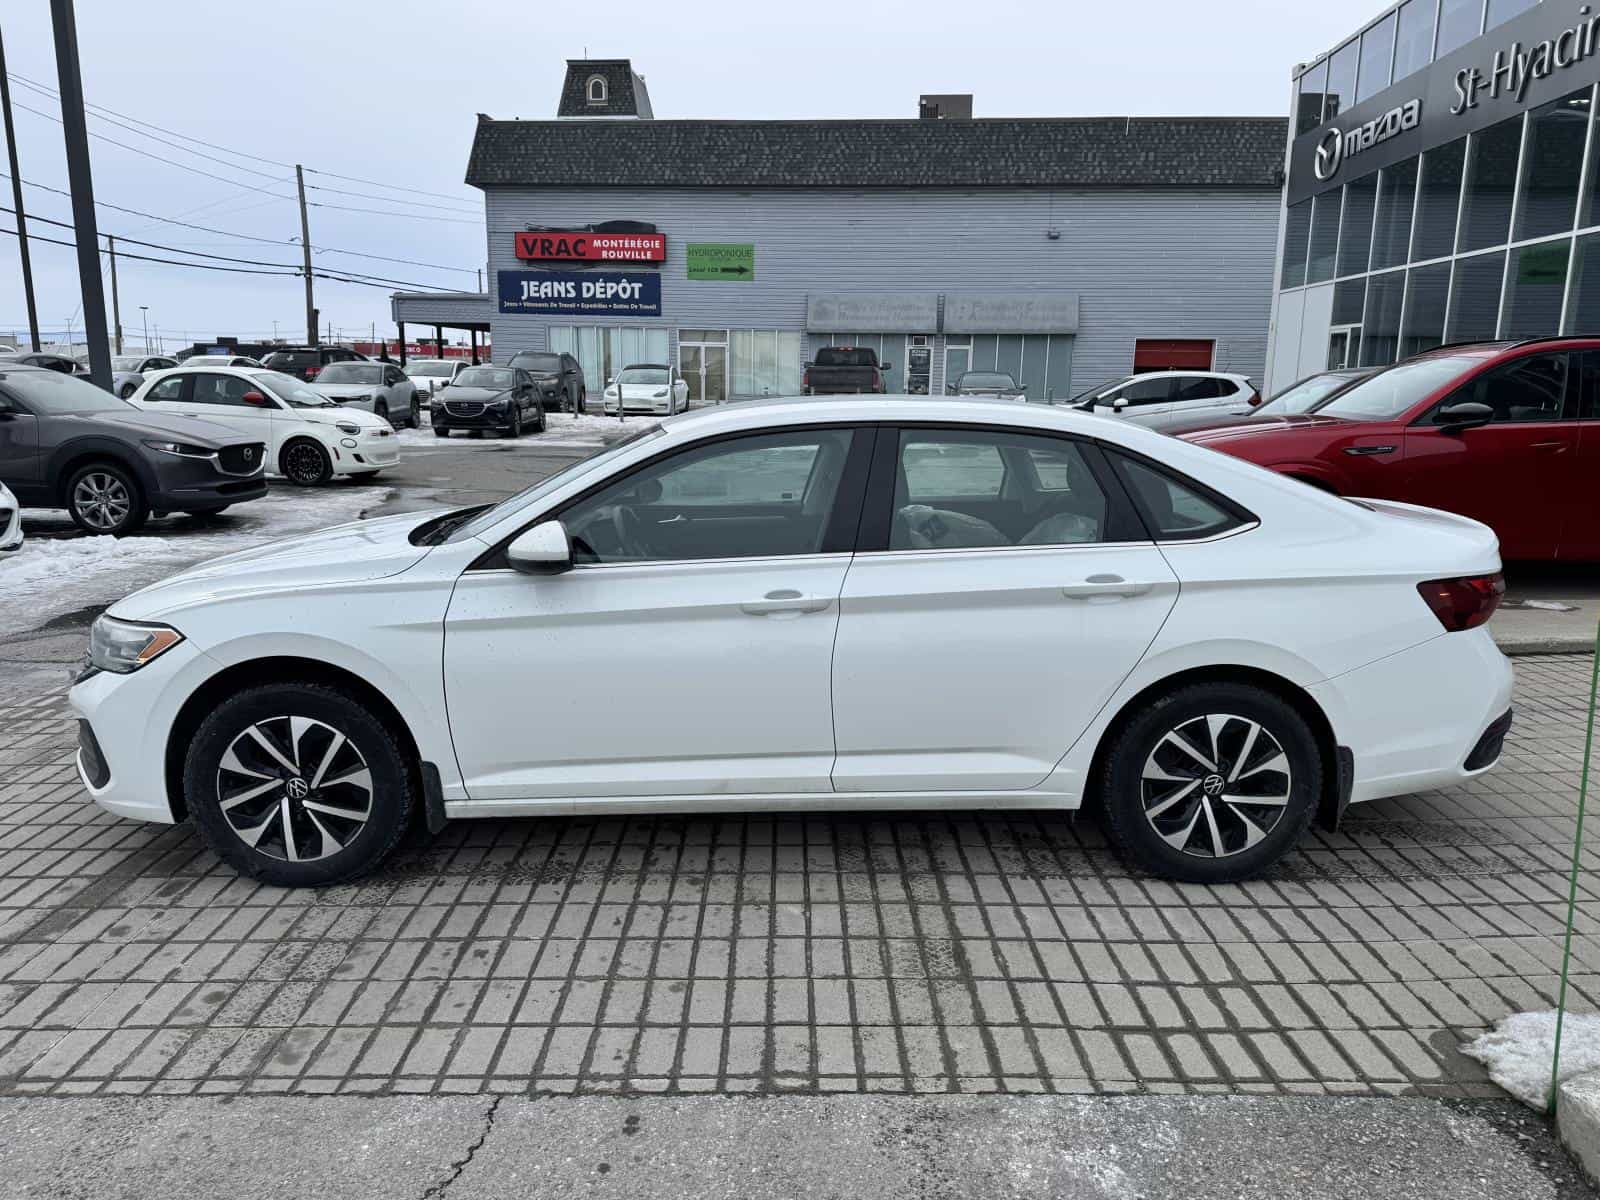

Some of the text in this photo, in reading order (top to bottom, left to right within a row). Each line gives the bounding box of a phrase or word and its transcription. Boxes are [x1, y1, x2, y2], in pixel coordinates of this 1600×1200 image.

[1344, 98, 1421, 158] mazda
[522, 238, 586, 257] VRAC
[592, 238, 660, 249] MONTÉRÉGIE
[602, 250, 652, 260] ROUVILLE
[688, 247, 752, 258] HYDROPONIQUE
[520, 278, 643, 300] JEANS DÉPÔT
